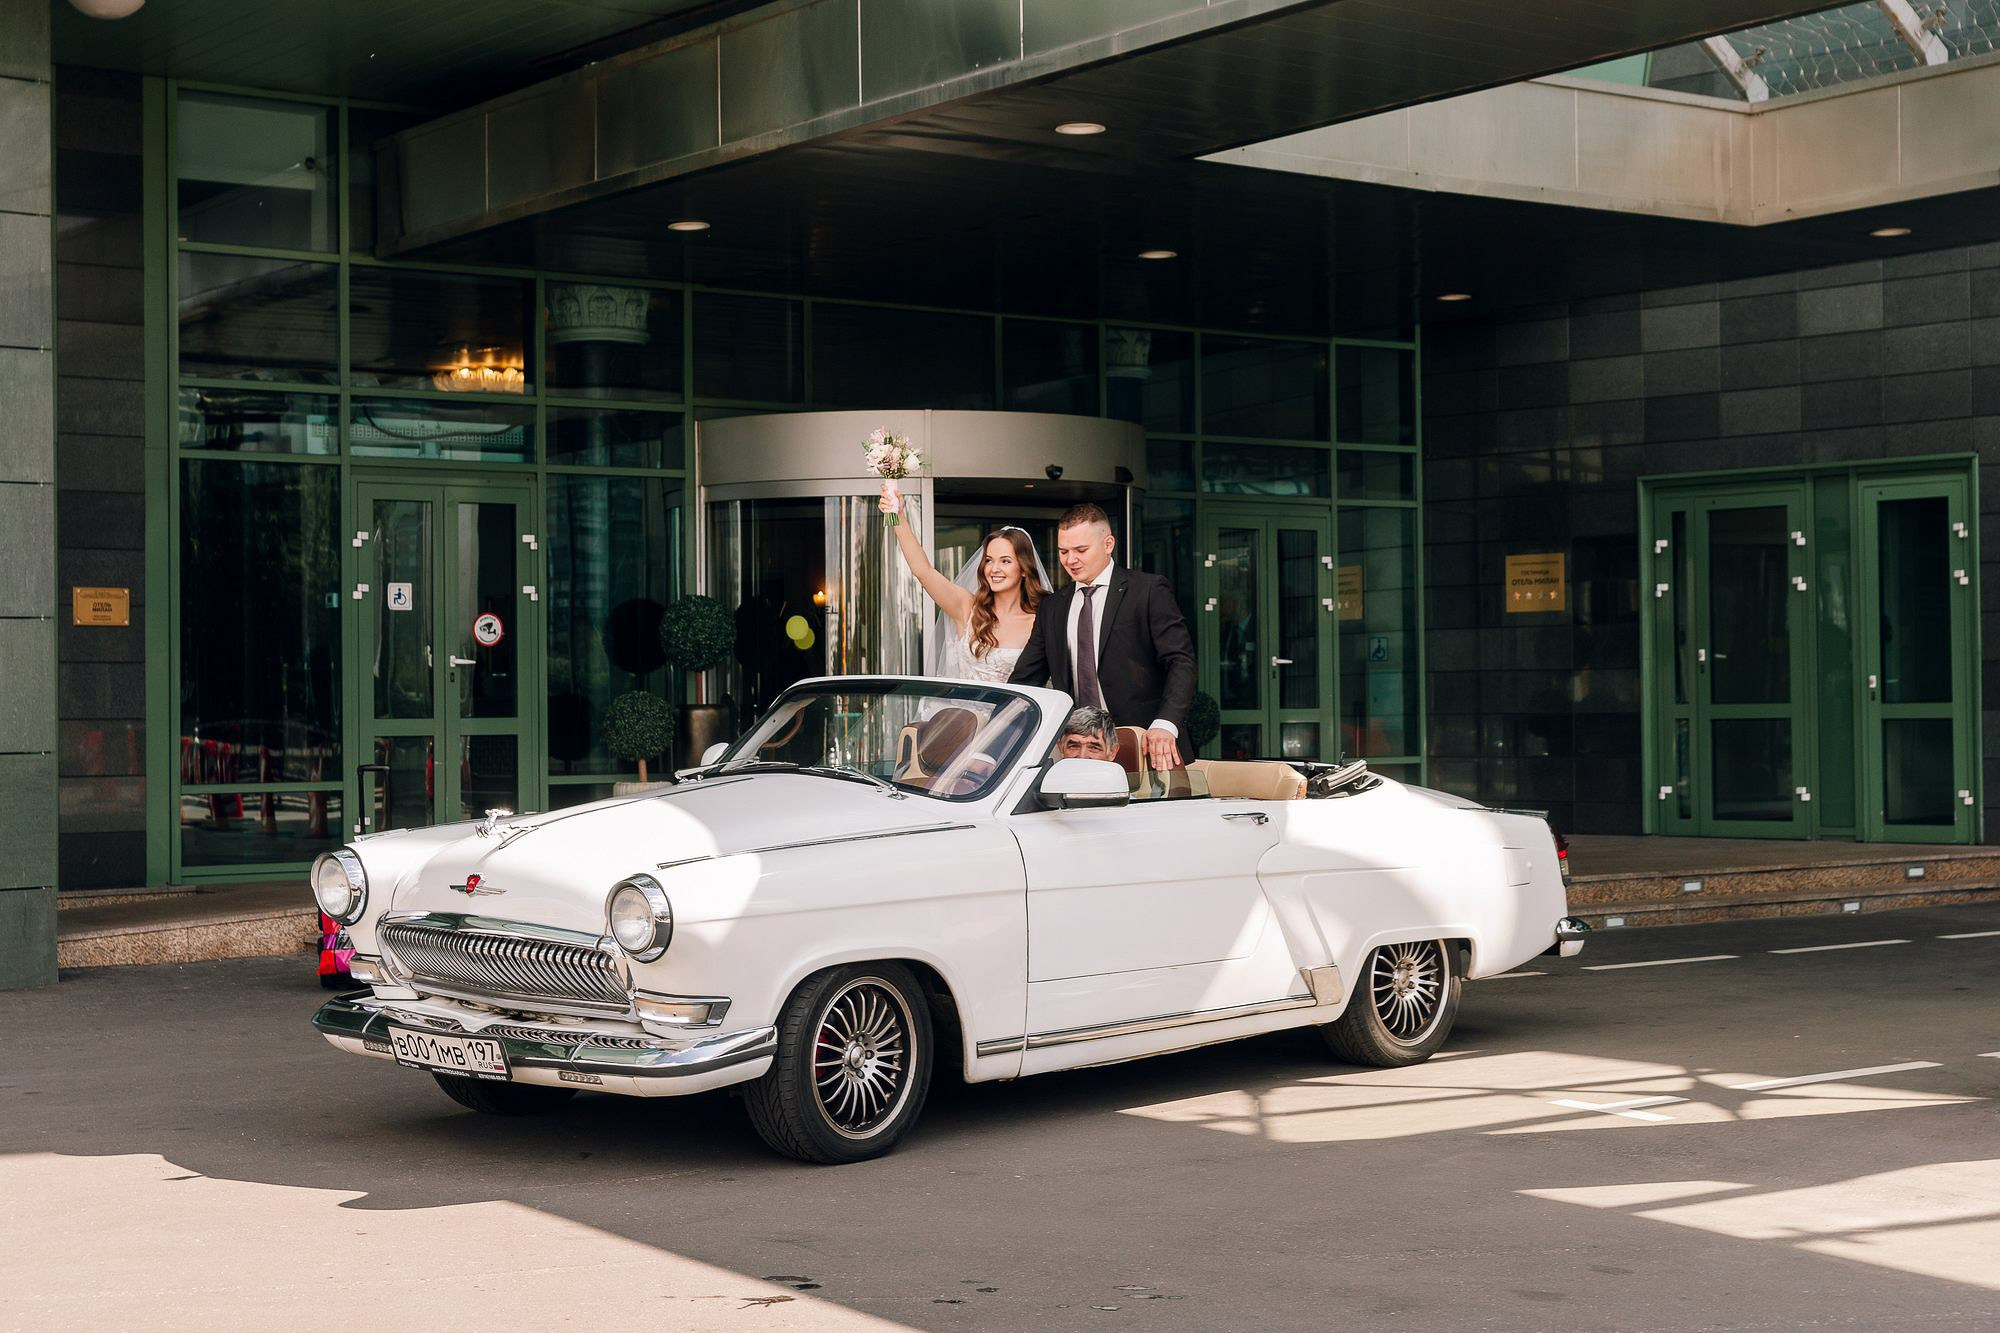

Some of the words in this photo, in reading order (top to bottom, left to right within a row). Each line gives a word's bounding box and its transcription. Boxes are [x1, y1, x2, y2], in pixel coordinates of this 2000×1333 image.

[1511, 578, 1533, 586] ОТЕЛЬ
[1534, 577, 1560, 585] МИЛАН
[466, 1041, 496, 1062] 197
[477, 1061, 494, 1070] RUS
